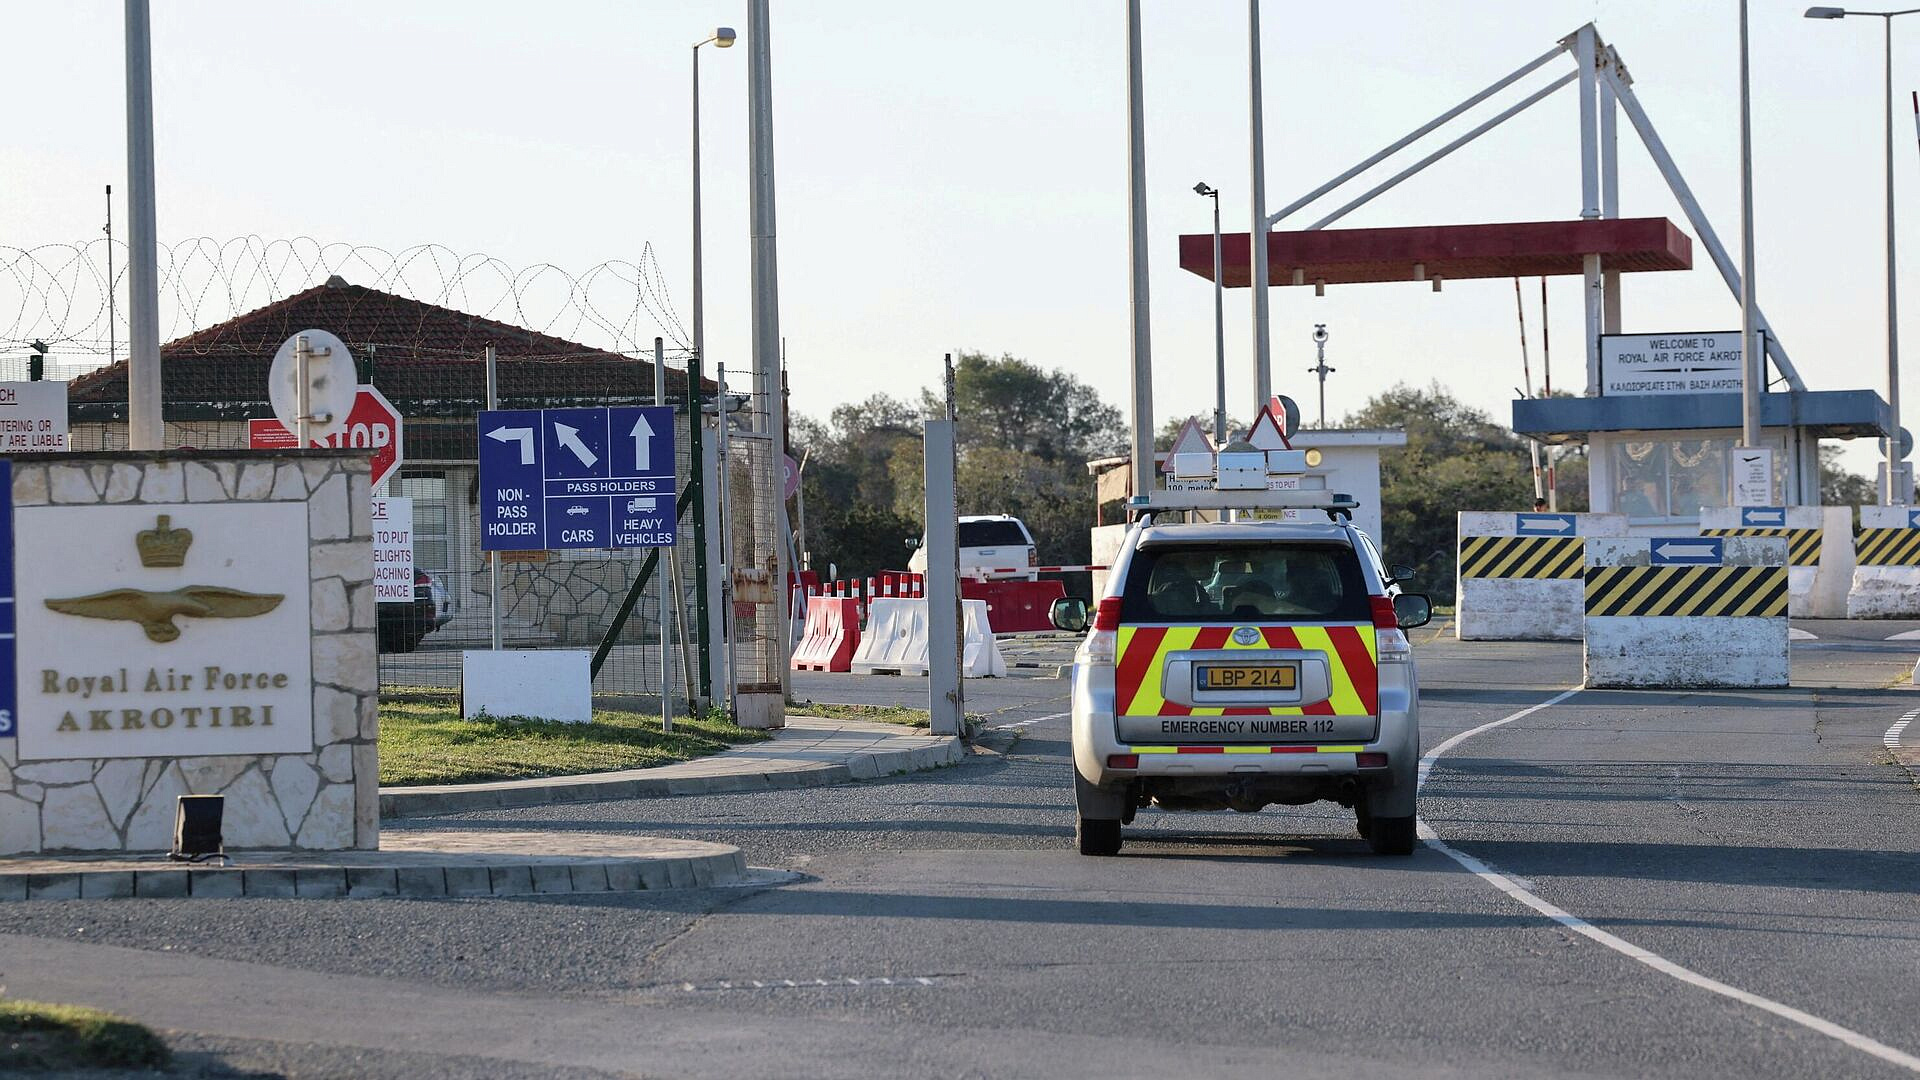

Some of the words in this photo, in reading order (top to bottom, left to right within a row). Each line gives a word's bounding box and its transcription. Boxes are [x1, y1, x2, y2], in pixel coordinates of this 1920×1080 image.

[1650, 339, 1699, 350] WELCOME
[1703, 338, 1715, 349] TO
[1618, 353, 1648, 364] ROYAL
[1653, 352, 1669, 363] AIR
[1674, 351, 1705, 362] FORCE
[38, 420, 52, 432] OR
[9, 435, 26, 447] ARE
[32, 435, 63, 446] LIABLE
[567, 482, 598, 493] PASS
[600, 481, 657, 492] HOLDERS
[1284, 480, 1296, 489] PUT
[497, 506, 528, 519] PASS
[488, 522, 537, 536] HOLDER
[623, 518, 663, 530] HEAVY
[377, 531, 389, 543] TO
[391, 531, 409, 543] PUT
[561, 529, 595, 543] CARS
[615, 531, 673, 545] VEHICLES
[42, 668, 128, 698] Royal
[144, 667, 193, 692] Air
[204, 666, 289, 690] Force
[1210, 670, 1245, 686] LBP
[1250, 670, 1281, 685] 214
[56, 705, 274, 732] AKROTIRI
[1161, 720, 1245, 734] EMERGENCY
[1250, 720, 1308, 733] NUMBER
[1313, 720, 1334, 733] 112
